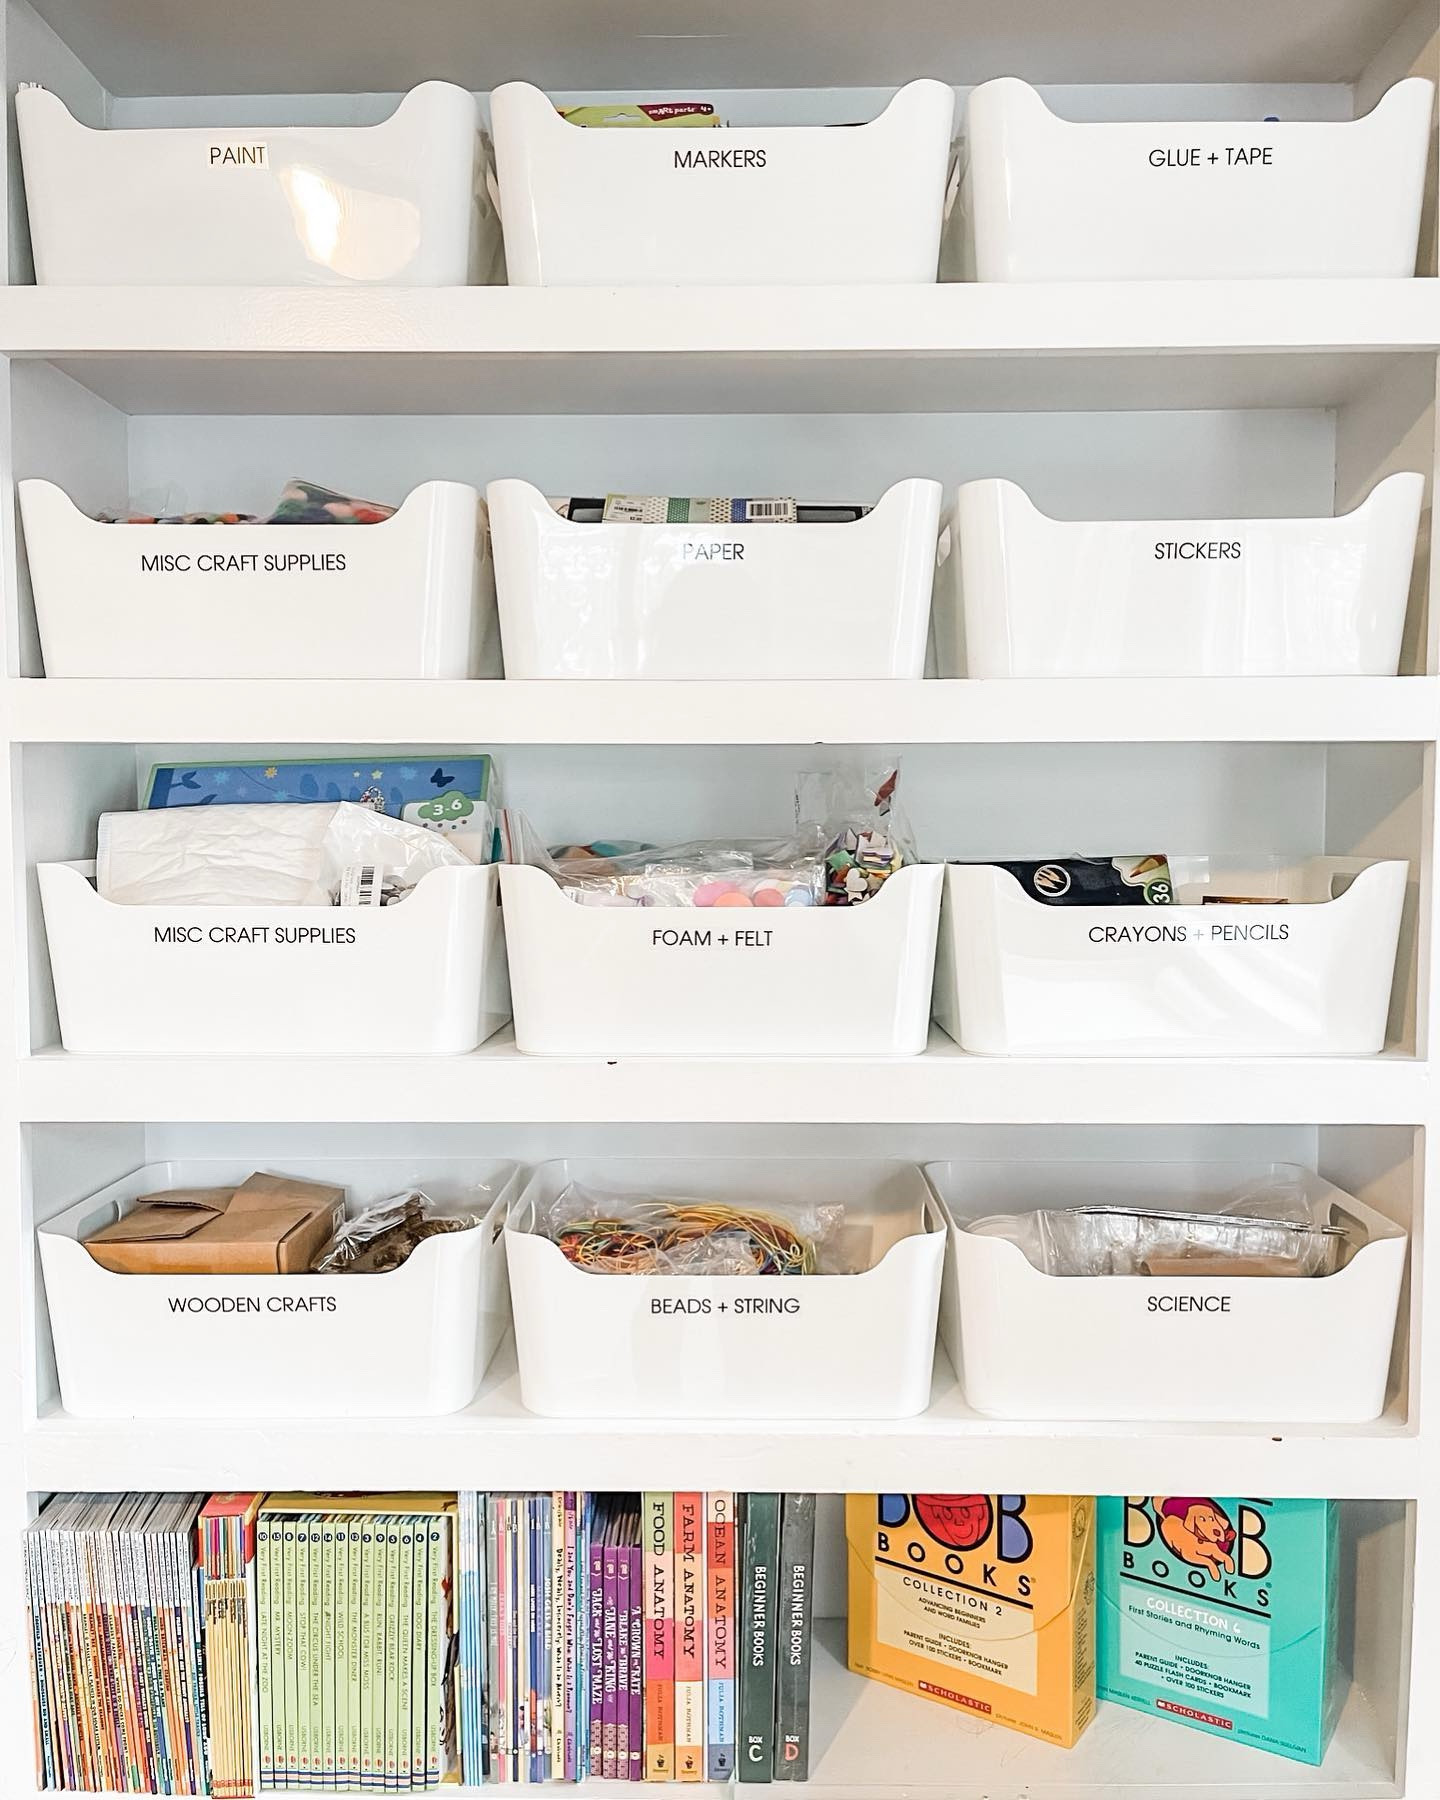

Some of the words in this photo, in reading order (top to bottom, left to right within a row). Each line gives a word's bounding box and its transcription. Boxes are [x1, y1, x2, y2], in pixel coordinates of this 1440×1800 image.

[209, 146, 266, 165] PAINT
[674, 149, 767, 169] MARKERS
[1148, 148, 1201, 168] GLUE
[1206, 152, 1220, 165] +
[1224, 147, 1274, 166] TAPE
[141, 554, 191, 572] MISC
[196, 554, 259, 572] CRAFT
[263, 553, 347, 572] SUPPLIES
[683, 542, 745, 561] PAPER
[1154, 541, 1242, 560] STICKERS
[433, 799, 462, 816] 3-6
[1152, 884, 1171, 903] 36
[154, 926, 203, 943] MISC
[208, 926, 270, 944] CRAFT
[274, 926, 356, 944] SUPPLIES
[652, 929, 712, 947] FOAM
[716, 933, 729, 946] +
[734, 930, 774, 947] FELT
[1088, 925, 1187, 944] CRAYONS
[1193, 927, 1205, 940] +
[1211, 923, 1289, 941] PENCILS
[167, 1296, 261, 1314] WOODEN
[266, 1295, 337, 1313] CRAFTS
[650, 1298, 712, 1315] BEADS
[716, 1301, 729, 1313] +
[733, 1297, 801, 1315] STRING
[1147, 1295, 1232, 1313] SCIENCE
[653, 1502, 665, 1556] FOOD
[683, 1504, 695, 1562] FARM
[715, 1499, 726, 1564] OCEAN
[1124, 1496, 1273, 1580] BOB
[878, 1532, 1031, 1597] BOOKS
[1123, 1551, 1270, 1607] BOOKS
[592, 1588, 602, 1617] JACK
[631, 1606, 641, 1615] A
[754, 1566, 767, 1628] BEGINNER
[791, 1565, 805, 1627] BEGINNER
[902, 1576, 988, 1612] COLLECTION
[996, 1606, 1002, 1616] 2
[918, 1597, 953, 1612] ADVANCING
[955, 1609, 986, 1623] BEGINNERS
[605, 1607, 616, 1638] JANE
[653, 1564, 665, 1660] ANATOMY
[683, 1569, 695, 1658] ANATOMY
[715, 1575, 726, 1669] ANATOMY
[938, 1610, 955, 1620] WORD
[956, 1616, 980, 1629] FAMILIES
[1146, 1597, 1228, 1630] COLLECTION
[619, 1611, 628, 1646] BLAKE
[631, 1619, 641, 1658] CROWN
[1128, 1605, 1144, 1616] First
[1146, 1610, 1173, 1624] Stories
[1175, 1620, 1192, 1630] and
[1195, 1624, 1232, 1642] Rhyming
[1234, 1637, 1261, 1650] Words
[592, 1638, 602, 1668] LOST
[753, 1631, 764, 1666] BOOKS
[790, 1630, 802, 1665] BOOKS
[904, 1630, 923, 1640] PARENT
[925, 1636, 942, 1647] GUIDE
[949, 1645, 982, 1660] DOORKNOB
[984, 1657, 1008, 1669] HANGER
[909, 1640, 924, 1648] OVER
[937, 1649, 962, 1662] STICKERS
[968, 1660, 1002, 1675] BOOKMARK
[605, 1660, 616, 1692] KING
[619, 1655, 628, 1690] BRAVE
[631, 1666, 641, 1695] KATE
[1135, 1651, 1158, 1663] PARENT
[1159, 1659, 1178, 1668] GUIDE
[1185, 1666, 1222, 1681] DOORKNOB
[1224, 1678, 1251, 1690] HANGER
[1144, 1662, 1164, 1672] PUZZLE
[1165, 1668, 1184, 1678] FLASH
[1185, 1674, 1207, 1685] CARDS
[1214, 1683, 1251, 1698] BOOKMARK
[592, 1670, 602, 1704] MAZE
[928, 1686, 990, 1712] SCHOLASTIC
[1166, 1676, 1183, 1686] OVER
[1197, 1685, 1224, 1698] STICKERS
[1165, 1703, 1231, 1729] SCHOLASTIC
[748, 1736, 763, 1744] BOX
[749, 1744, 763, 1762] C
[784, 1743, 799, 1760] D
